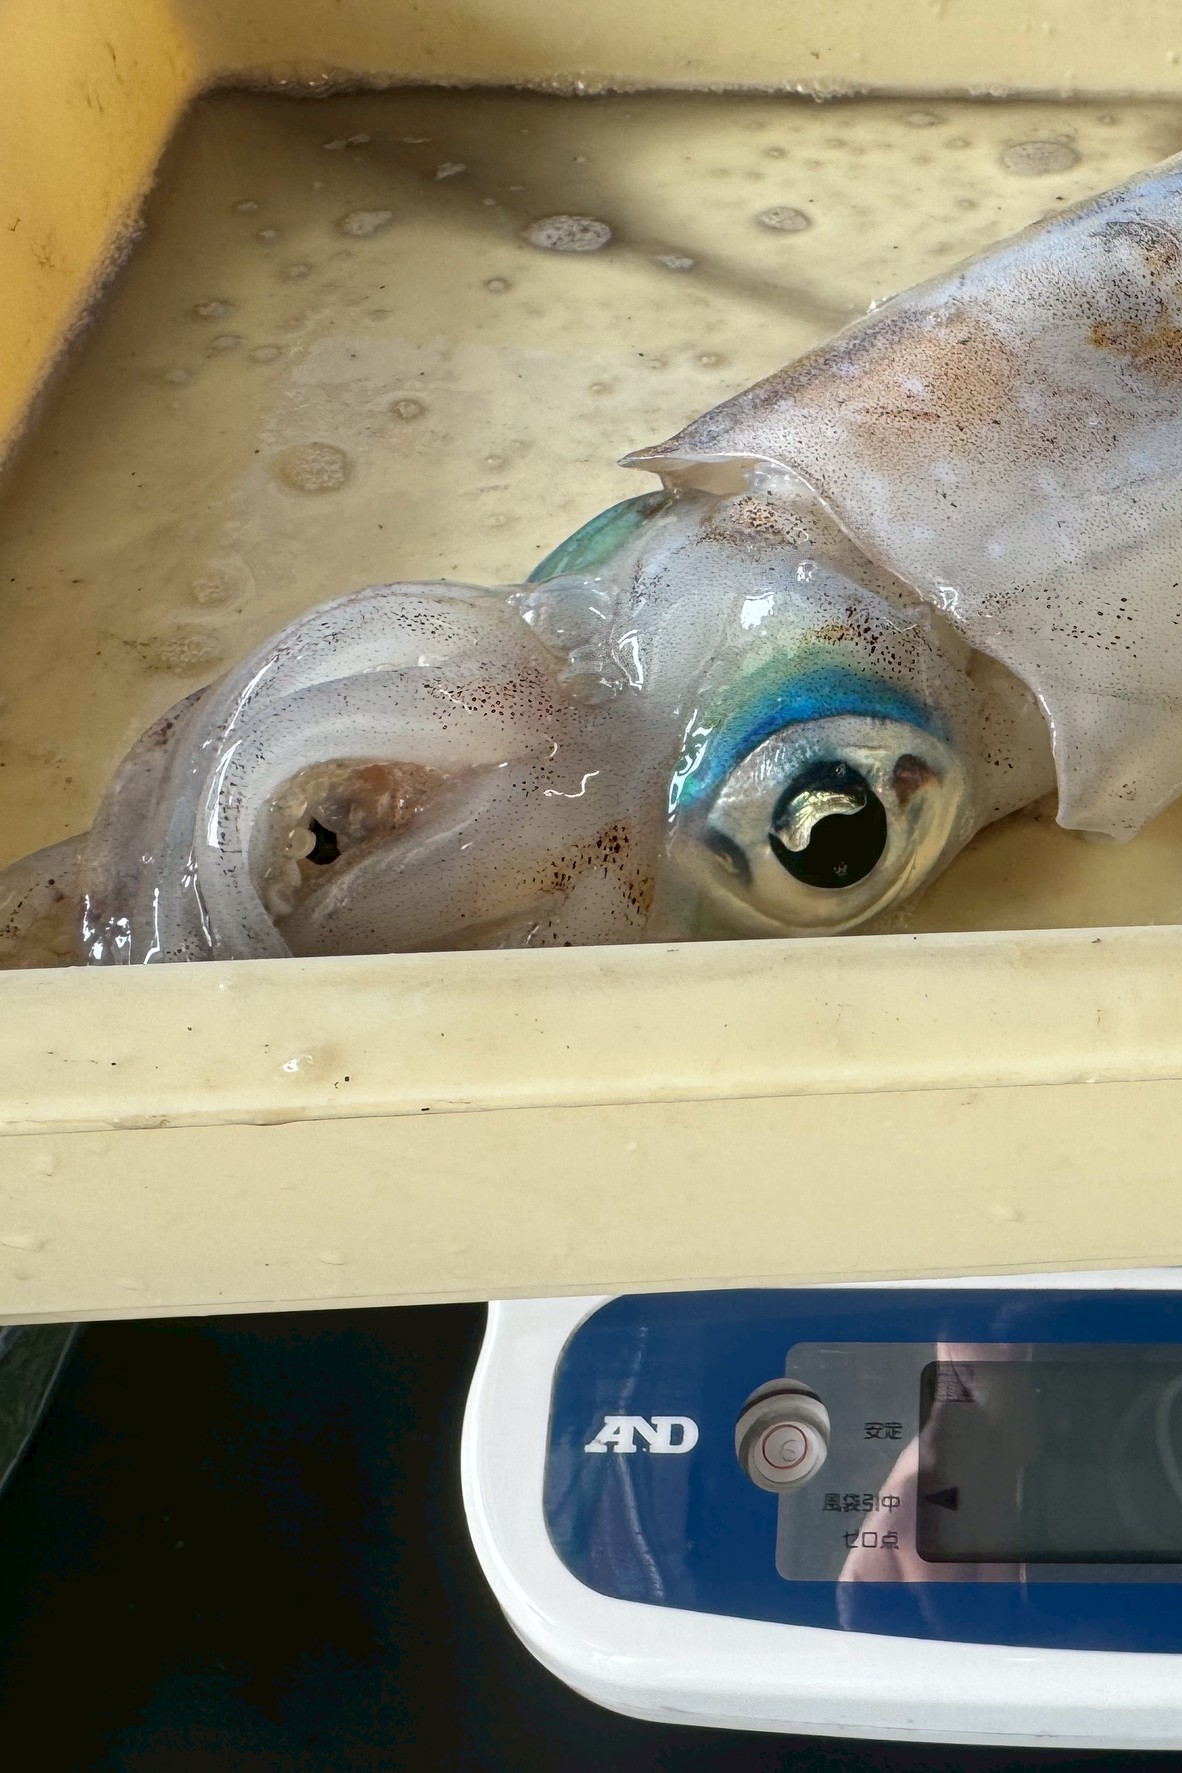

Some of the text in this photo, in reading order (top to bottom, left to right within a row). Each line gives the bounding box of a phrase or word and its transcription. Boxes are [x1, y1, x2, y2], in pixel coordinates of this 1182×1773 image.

[863, 1421, 903, 1440] 安定
[822, 1493, 900, 1513] 風袋引中
[841, 1530, 899, 1550] ゼロ点
